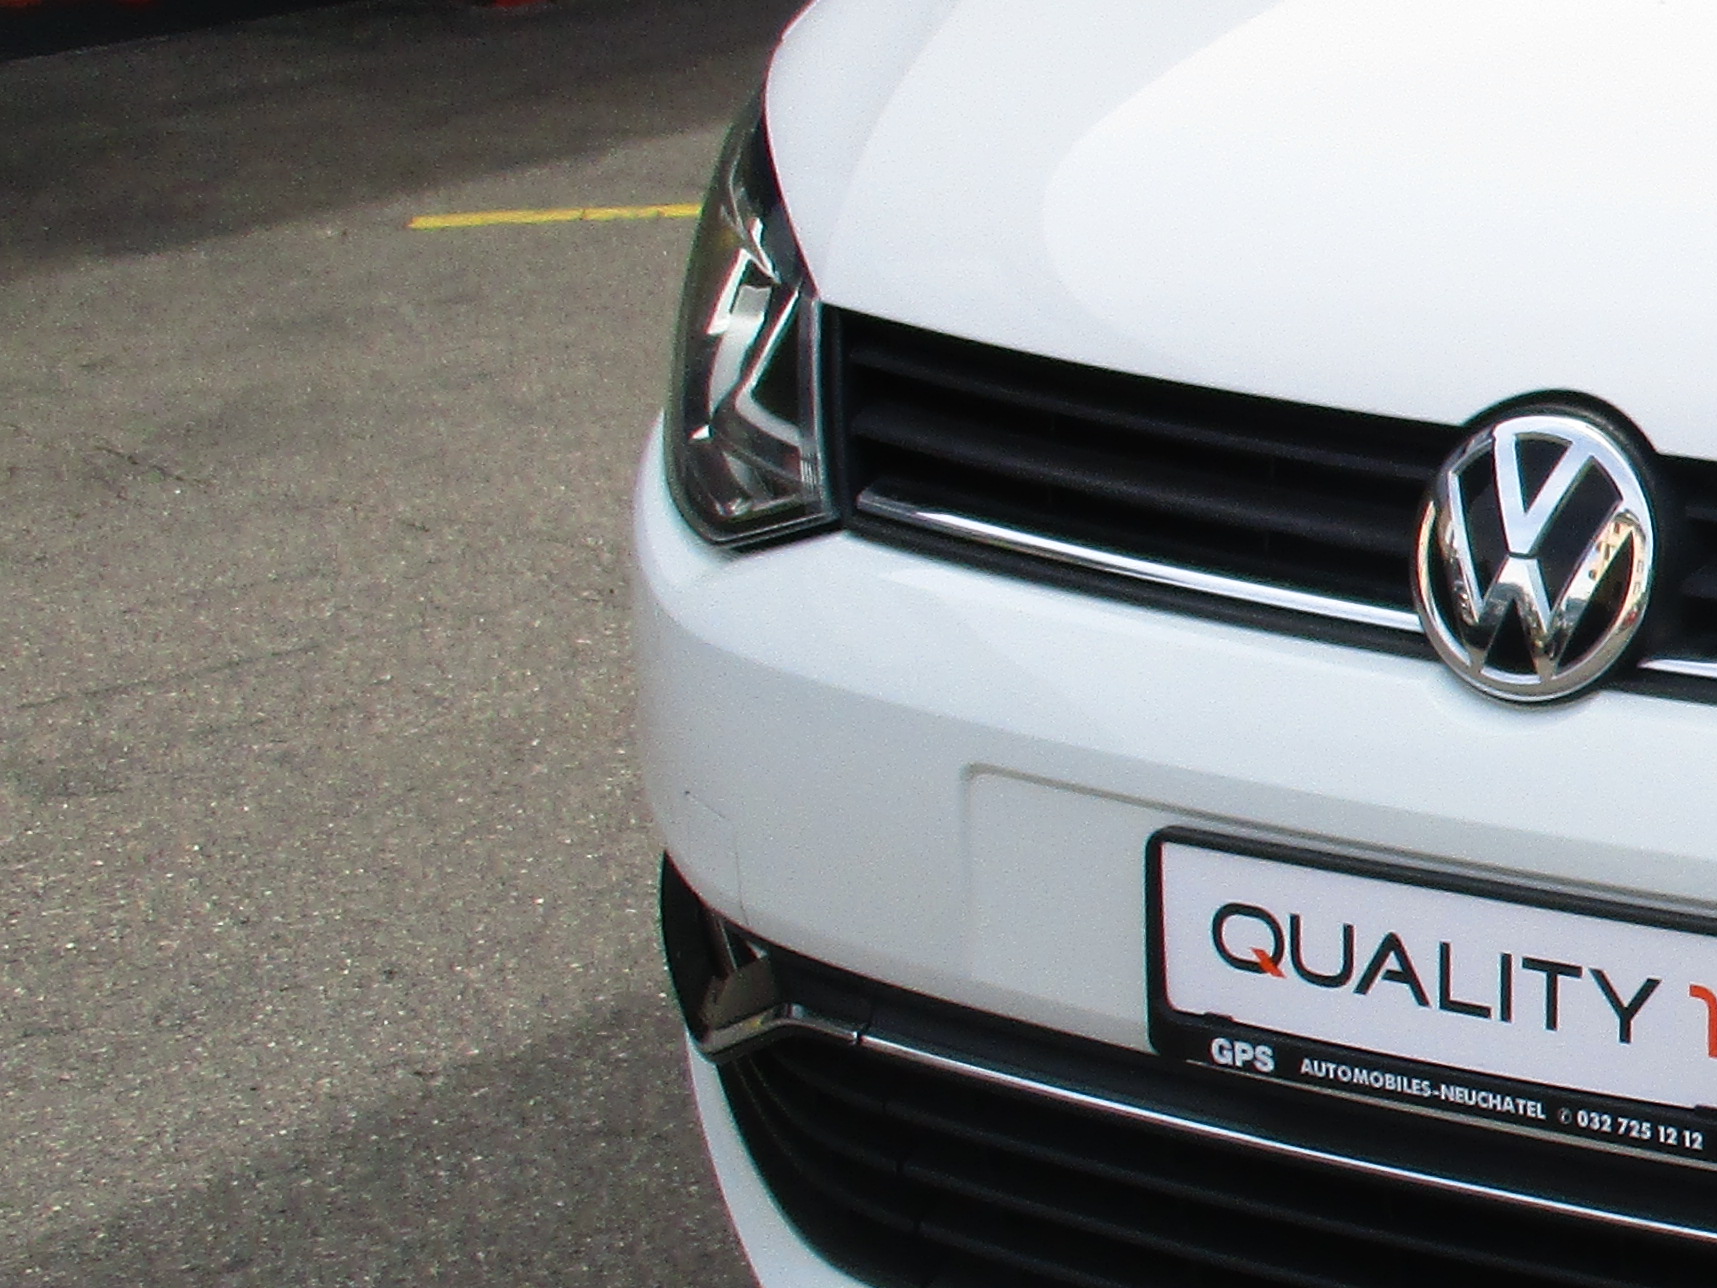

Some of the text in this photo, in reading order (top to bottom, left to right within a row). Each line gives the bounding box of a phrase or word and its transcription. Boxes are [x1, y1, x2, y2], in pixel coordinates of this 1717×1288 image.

[1210, 901, 1663, 1045] QUALITY
[1211, 1037, 1704, 1151] GPS AUTOMOBILES-NEUCHATEL 032 725 12 12
